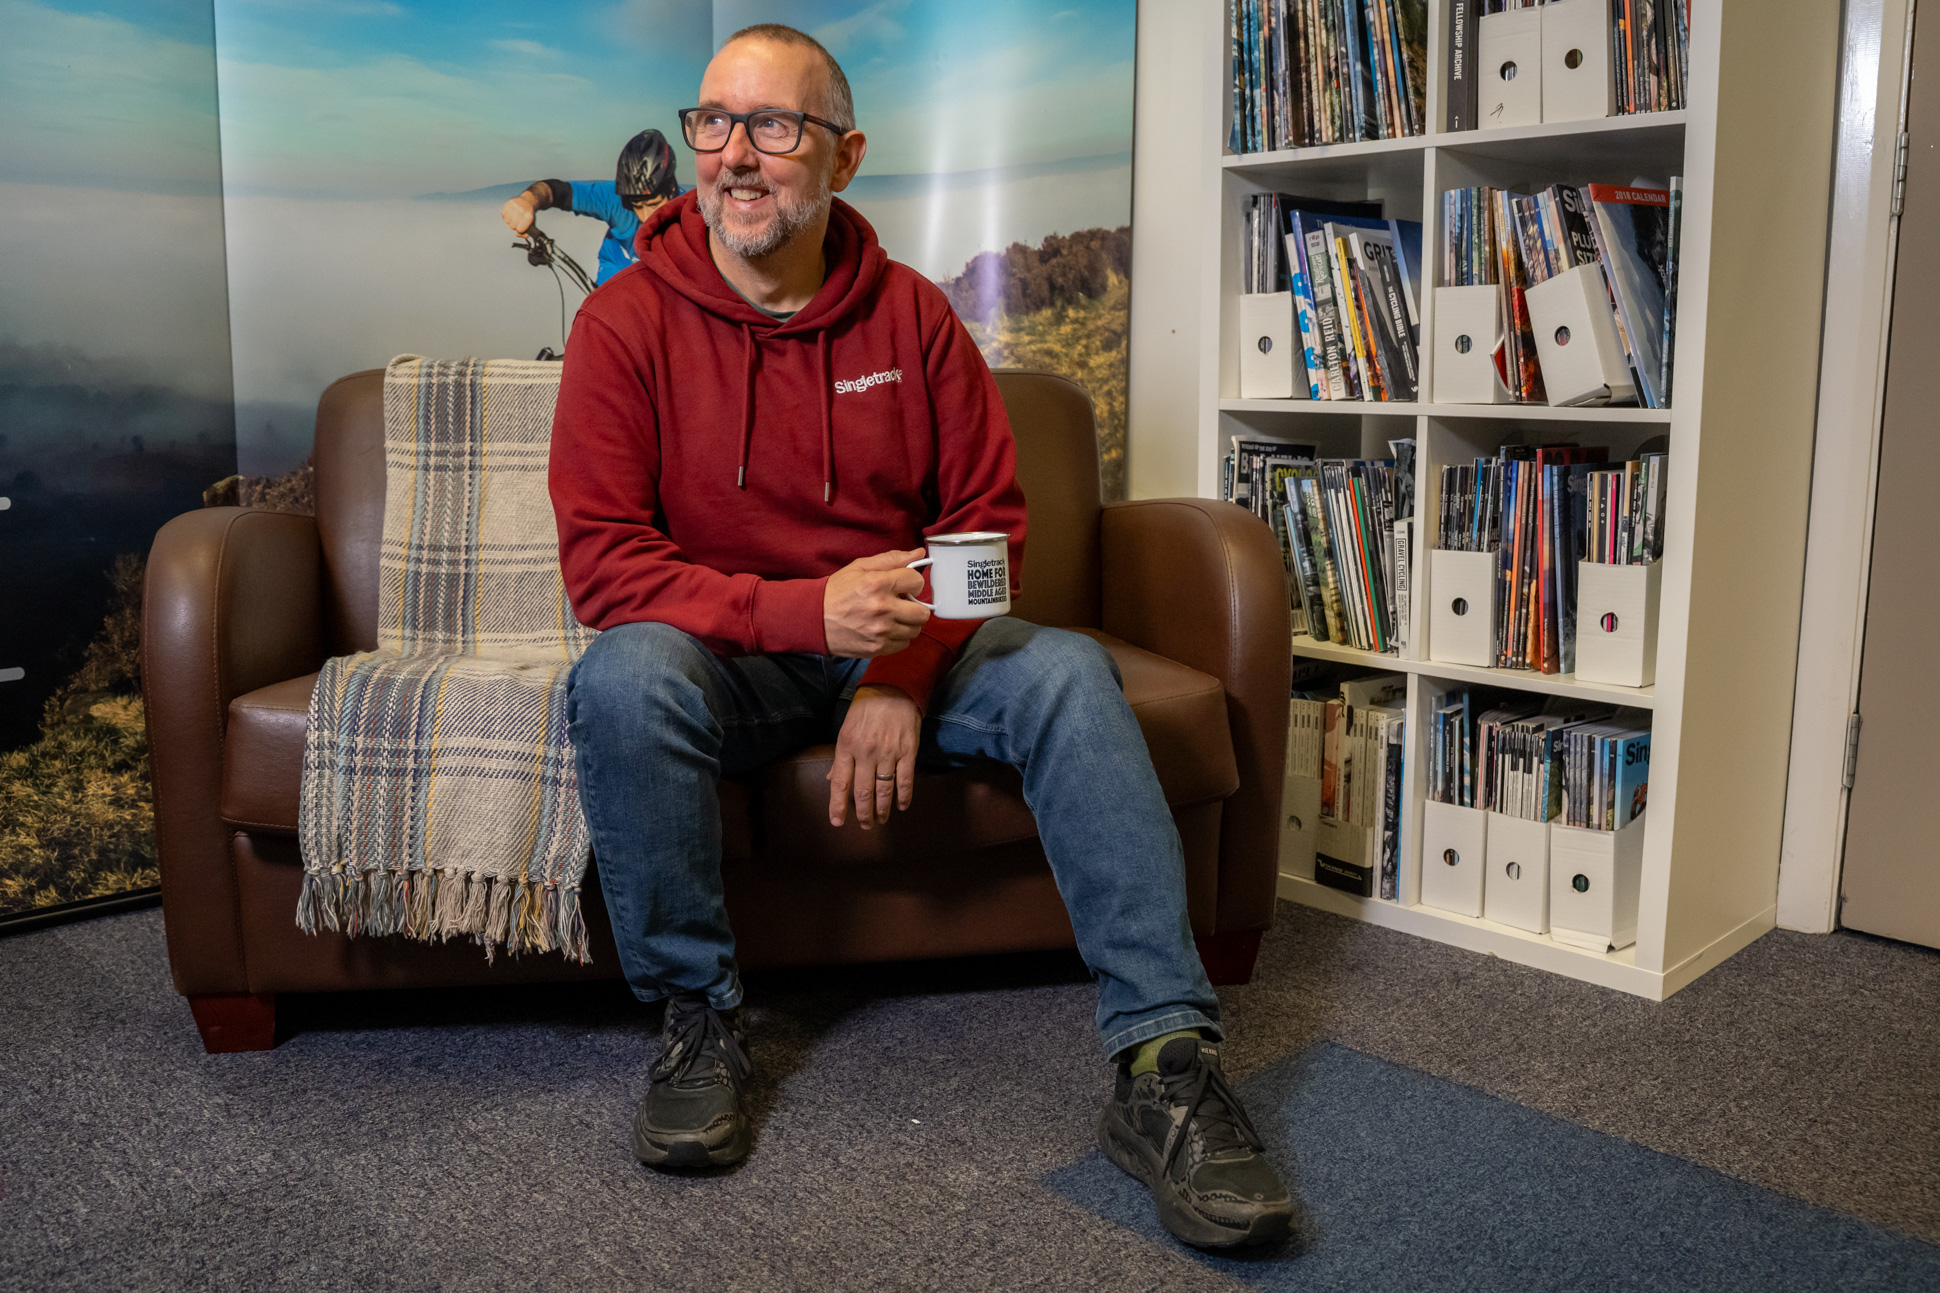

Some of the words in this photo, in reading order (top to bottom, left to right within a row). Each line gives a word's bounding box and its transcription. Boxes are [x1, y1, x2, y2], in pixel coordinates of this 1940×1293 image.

[1455, 3, 1464, 48] FELLOWSHIP
[1454, 50, 1463, 80] ARCHIVE
[1615, 190, 1631, 200] 2018
[1631, 191, 1666, 203] CALENDAR
[1571, 231, 1594, 250] PLU
[1576, 249, 1597, 265] SIZ
[1388, 292, 1402, 321] CYCLING
[1322, 317, 1336, 342] REID
[1394, 318, 1406, 339] BIBLE
[1326, 345, 1343, 392] CARLTON
[834, 367, 902, 394] Singletrack
[1397, 540, 1405, 562] GRAVEL
[967, 568, 993, 580] HOME
[1397, 564, 1406, 589] CYCLING
[967, 589, 994, 599] MIDDLE
